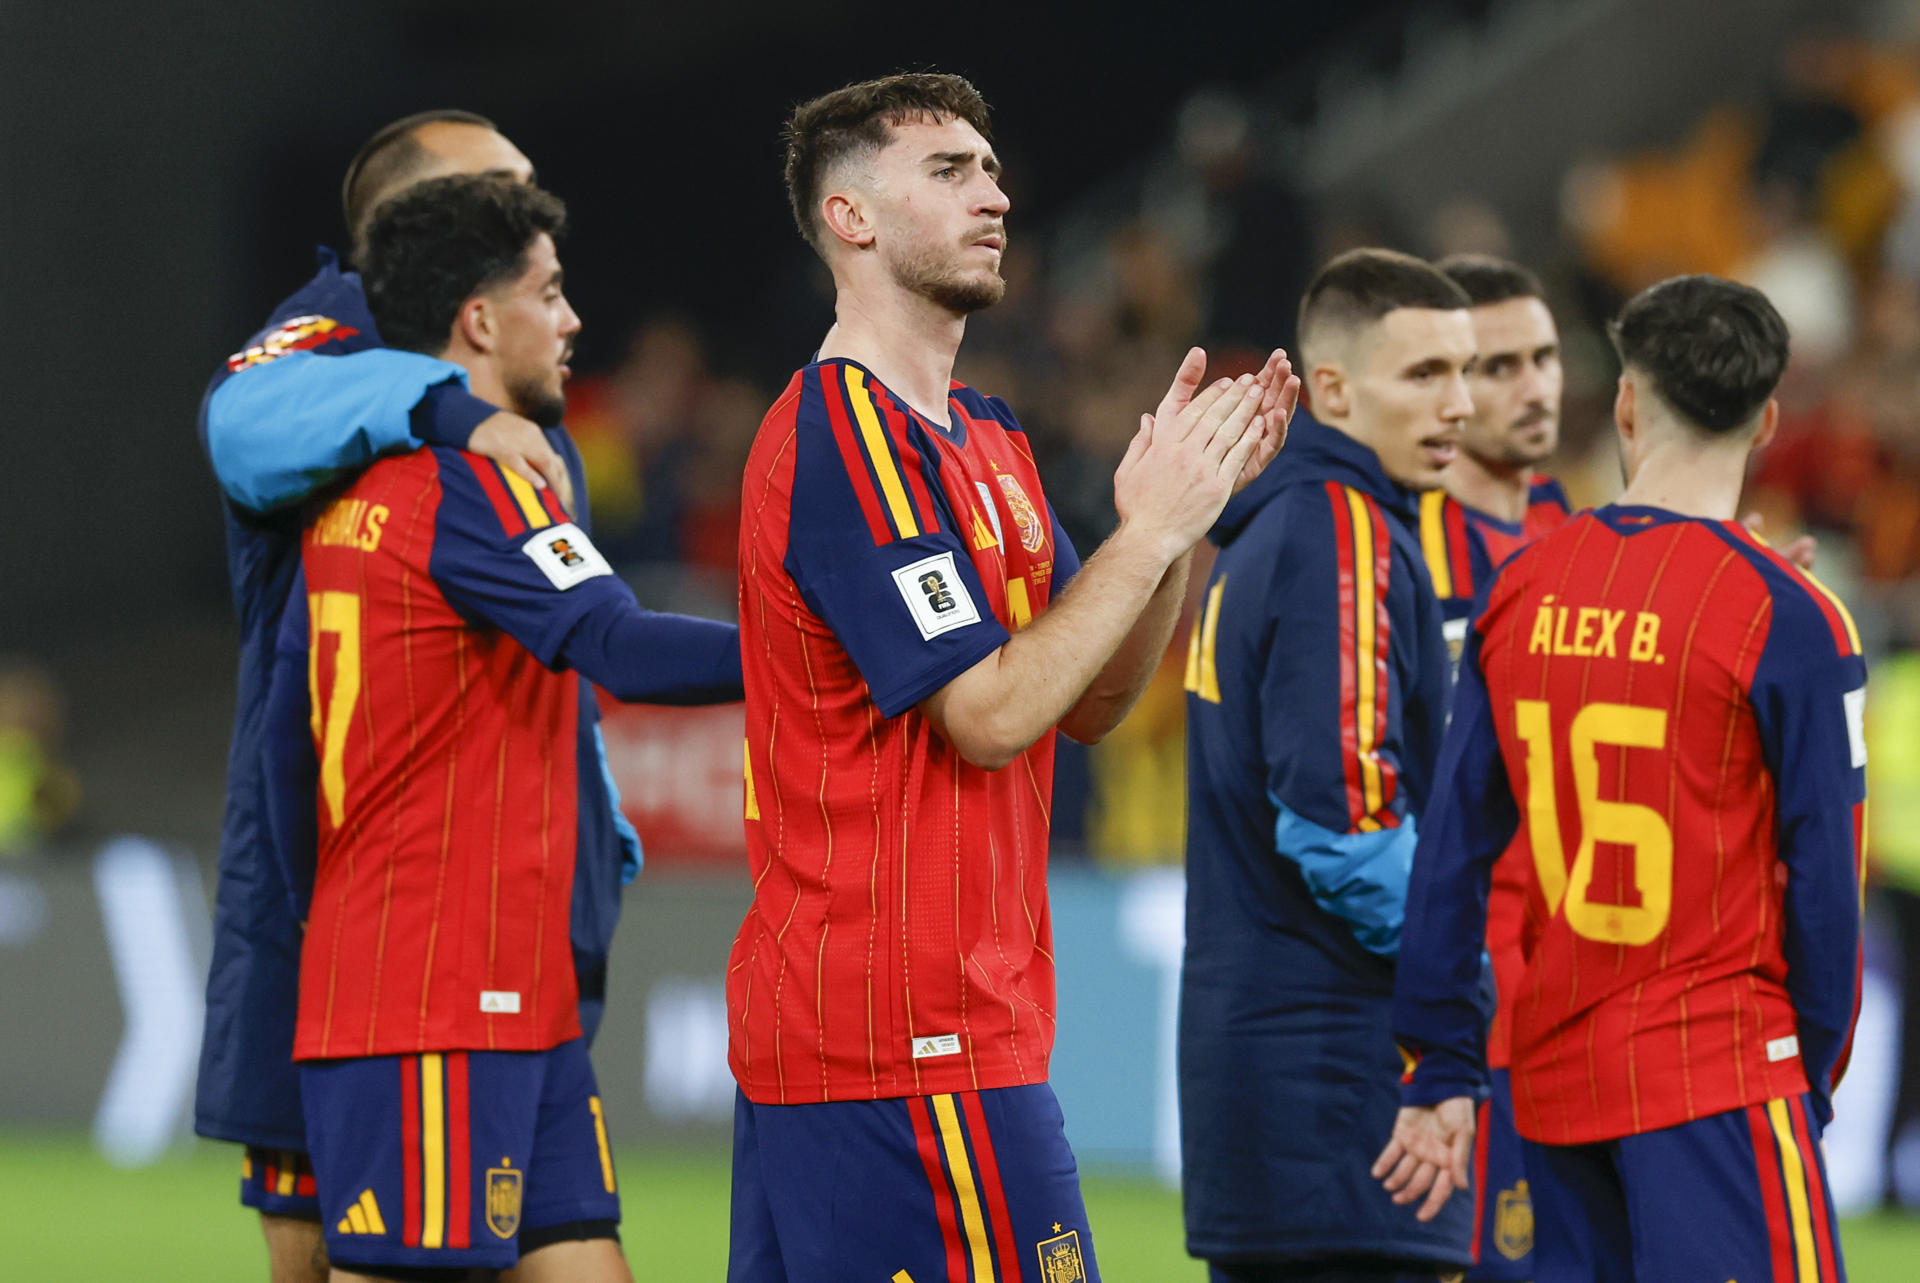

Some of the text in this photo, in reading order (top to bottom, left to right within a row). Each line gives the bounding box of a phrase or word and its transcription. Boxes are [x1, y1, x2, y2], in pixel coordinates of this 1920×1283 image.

[1529, 594, 1666, 666] ÁLEX B.
[1515, 700, 1674, 946] 16
